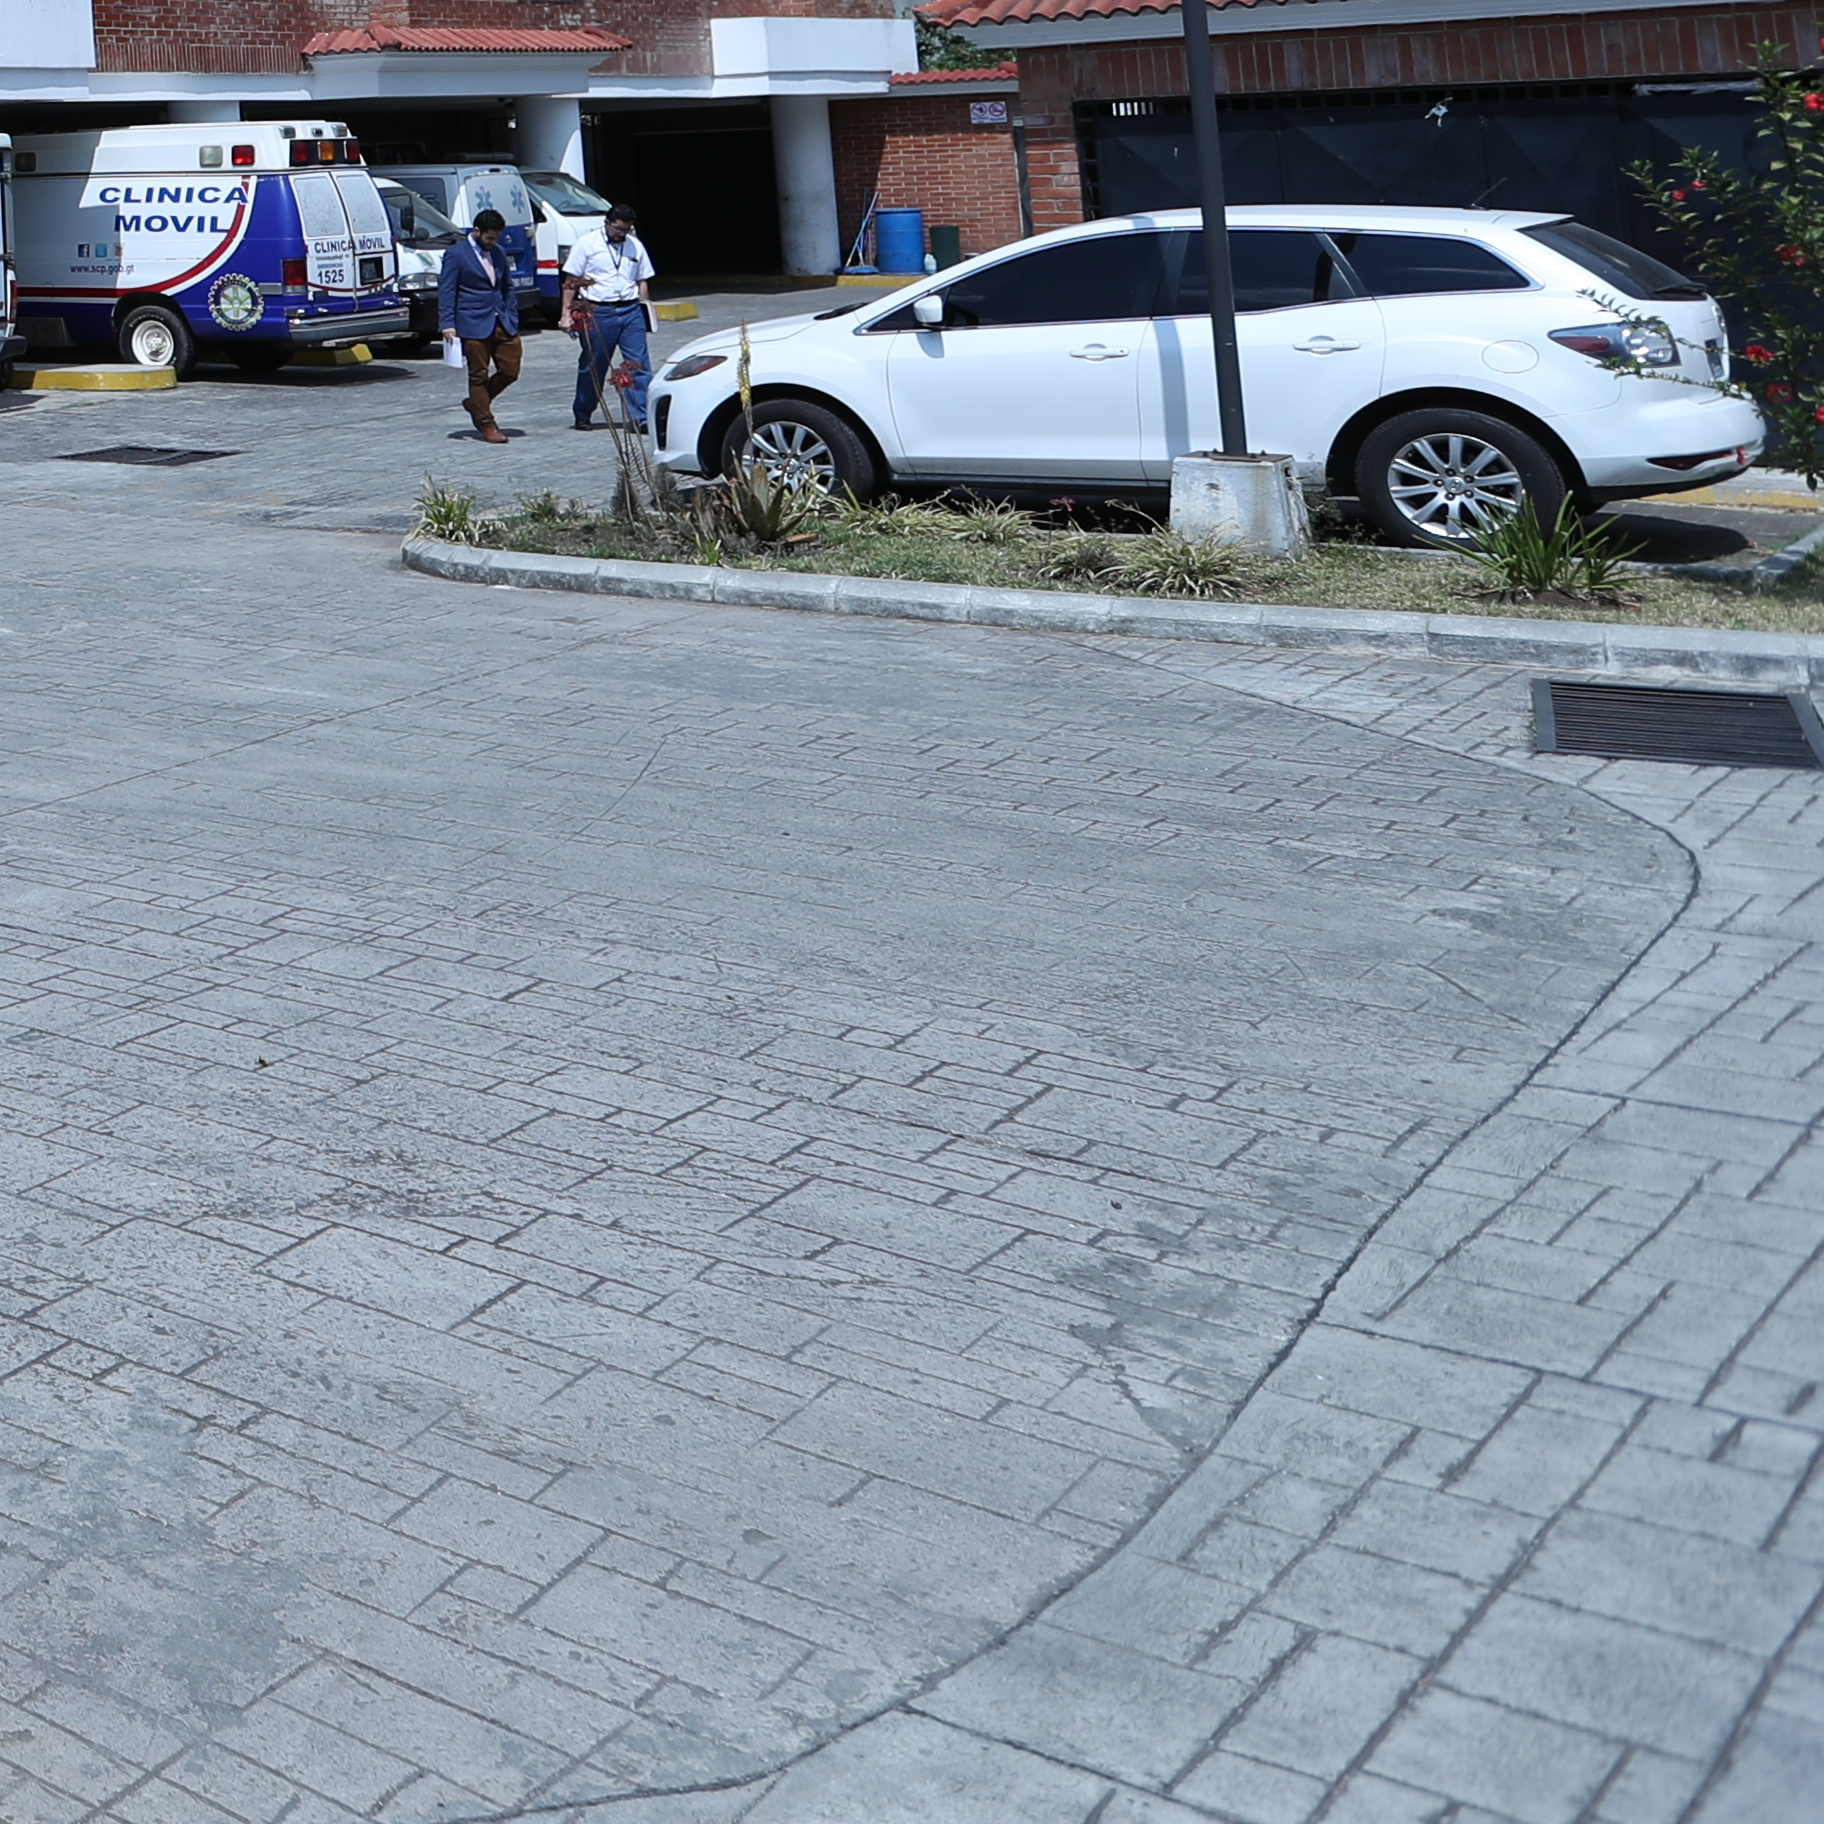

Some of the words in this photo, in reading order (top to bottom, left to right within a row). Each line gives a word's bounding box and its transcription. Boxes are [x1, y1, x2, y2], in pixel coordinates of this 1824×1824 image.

[99, 187, 248, 204] CLINICA
[114, 215, 231, 233] MOVIL
[314, 239, 357, 254] CLINICA
[358, 236, 386, 250] MOVIL
[69, 262, 135, 275] www.scp.gob.gt
[317, 268, 345, 284] 1525
